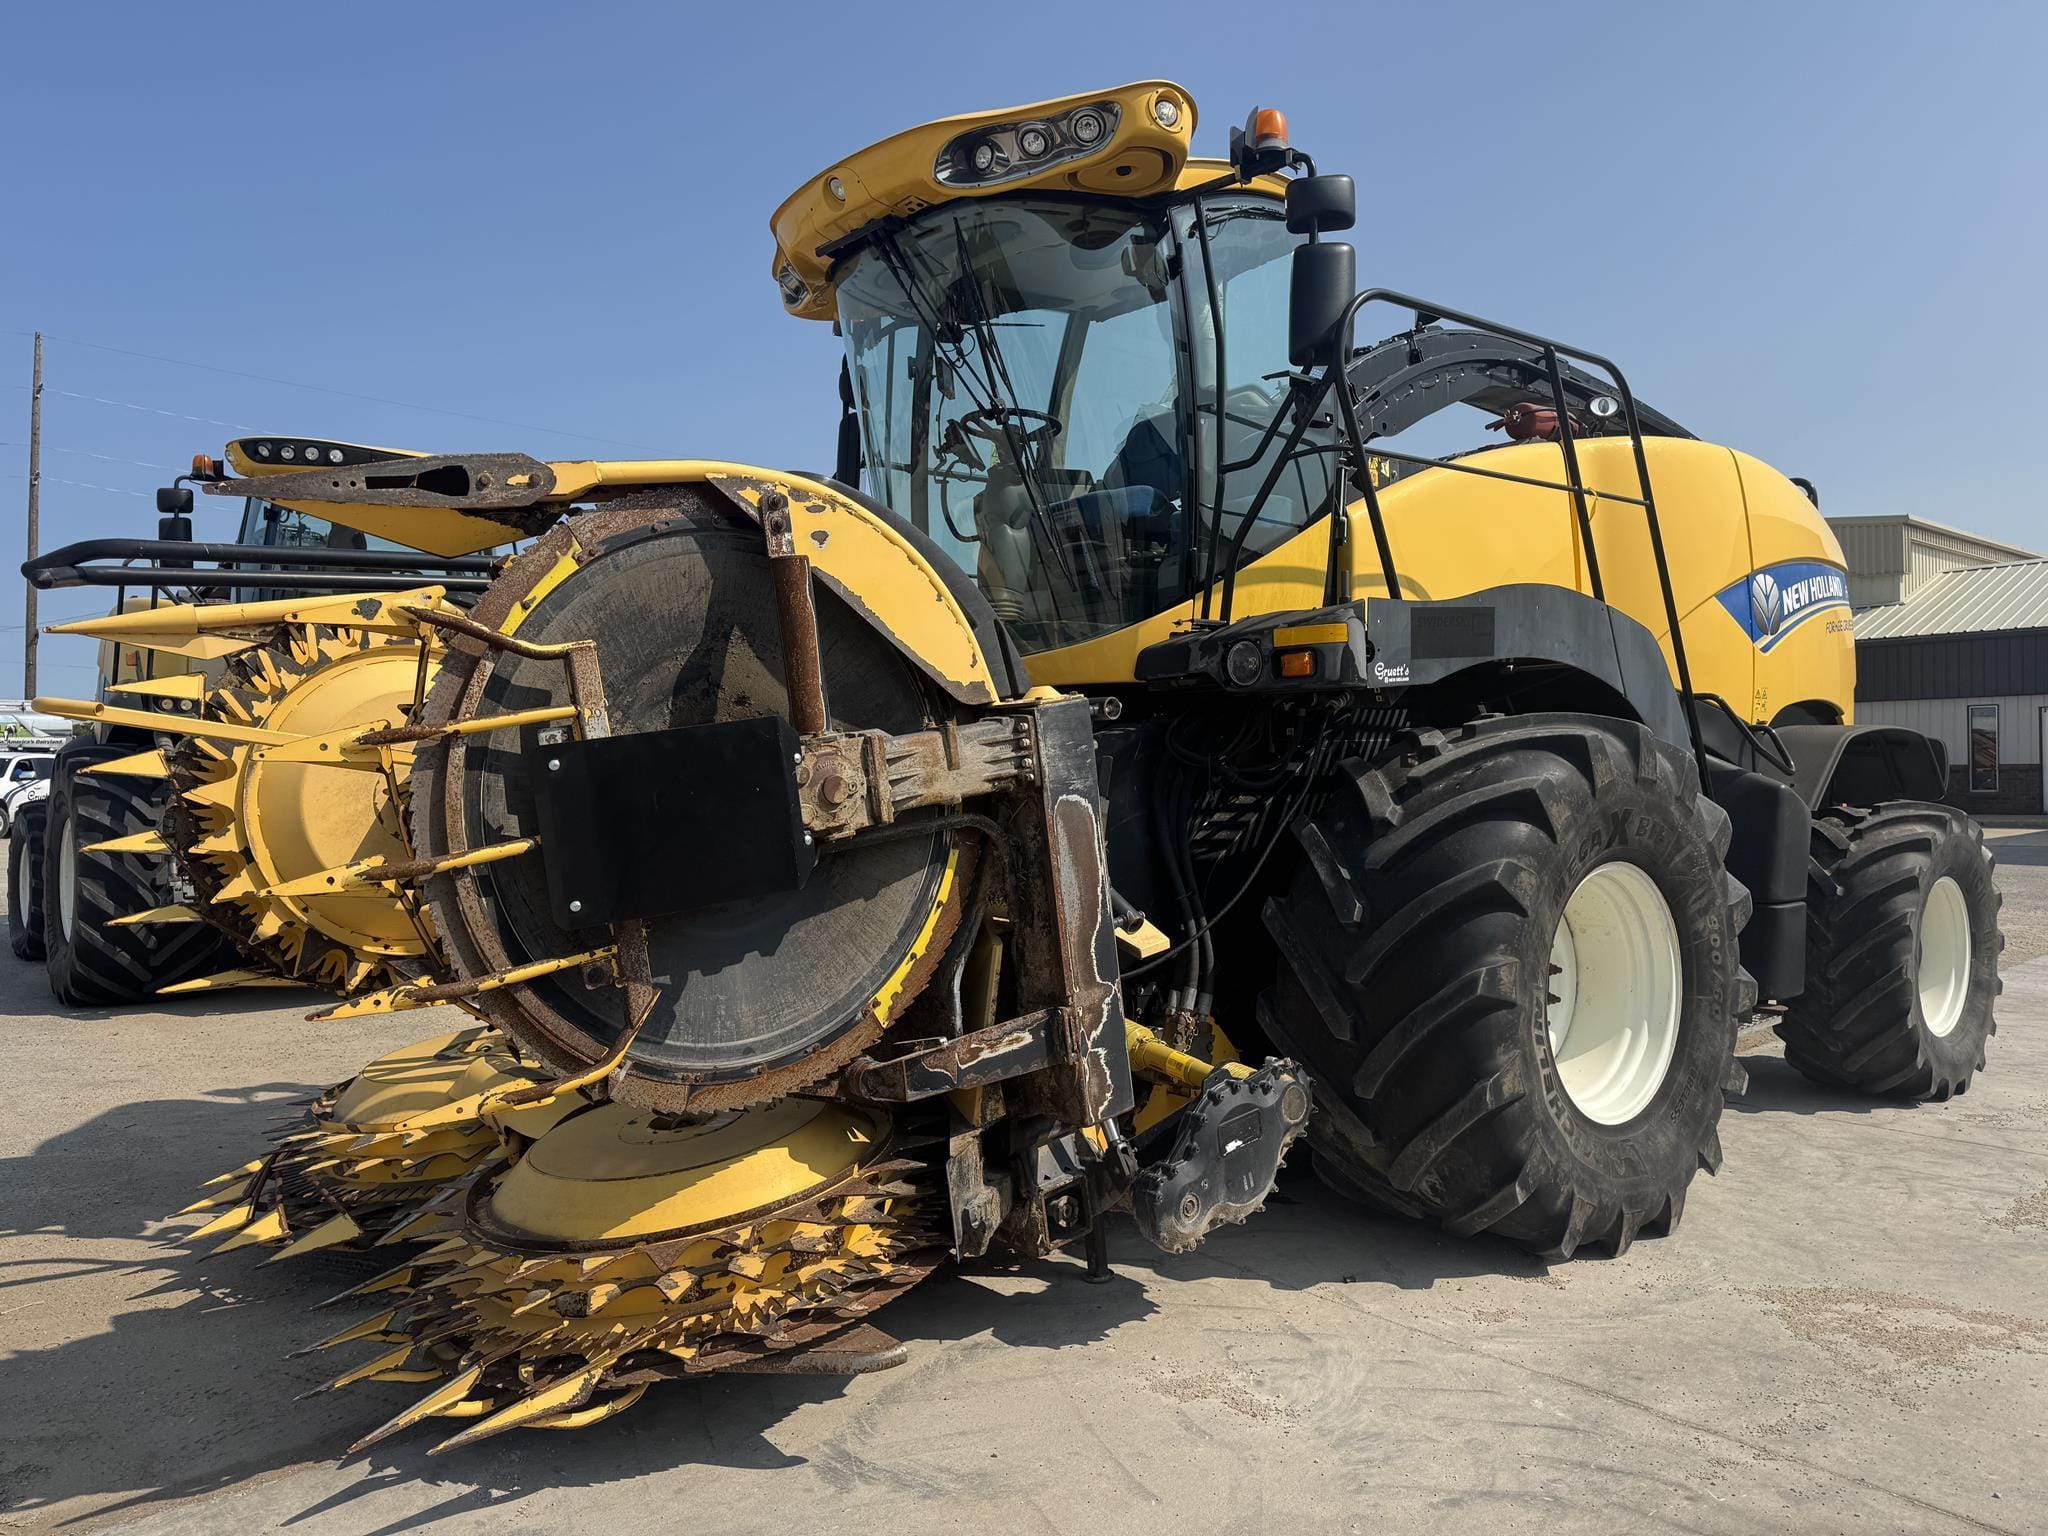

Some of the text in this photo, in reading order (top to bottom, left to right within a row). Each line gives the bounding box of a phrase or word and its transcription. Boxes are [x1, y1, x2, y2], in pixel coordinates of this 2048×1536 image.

[1783, 580, 1809, 615] NEW
[1810, 576, 1842, 601] HOLLAND
[1375, 662, 1409, 680] Gruett's
